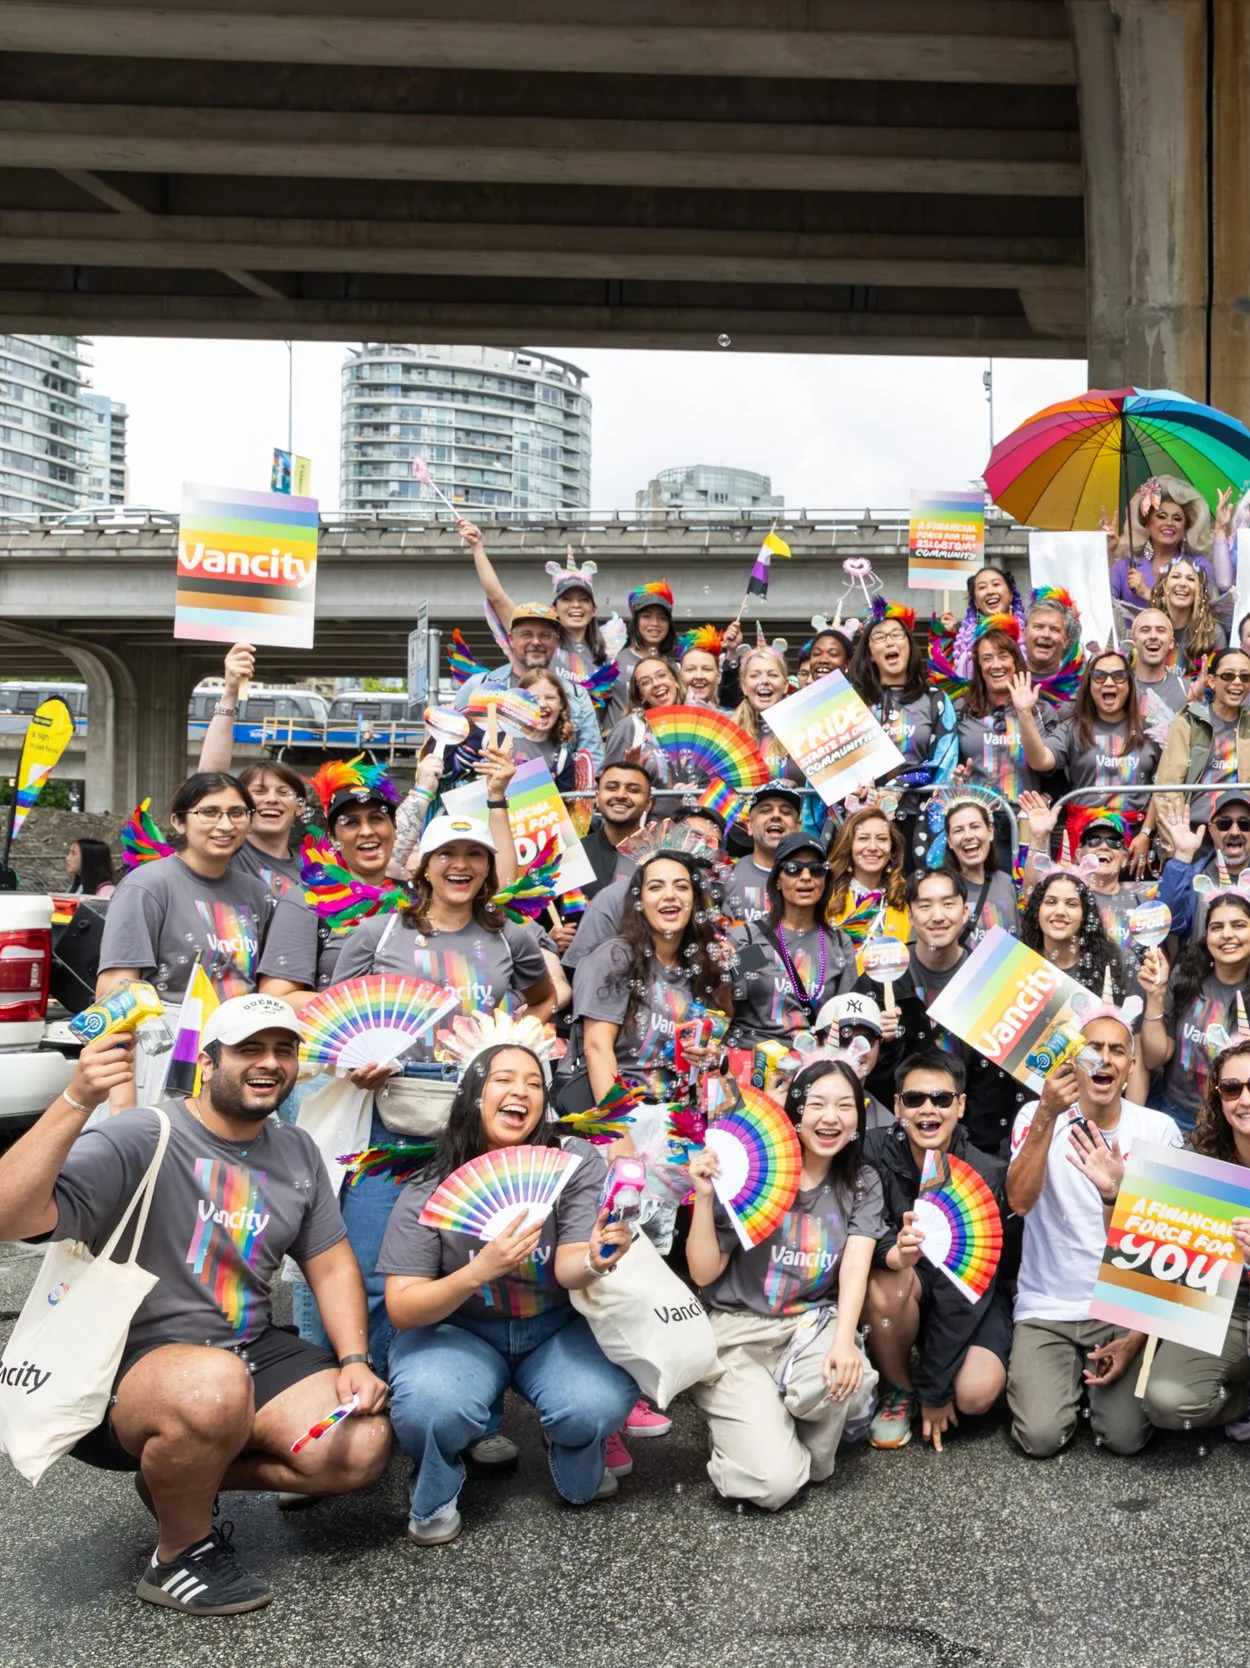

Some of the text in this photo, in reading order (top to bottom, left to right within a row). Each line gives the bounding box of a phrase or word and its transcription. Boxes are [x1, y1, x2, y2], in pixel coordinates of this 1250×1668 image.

[178, 541, 316, 589] Vancity
[915, 548, 977, 560] COMMUNITY
[791, 701, 870, 758] PRIDE
[983, 732, 1023, 747] Vancit
[799, 740, 839, 768] STARTS
[839, 734, 851, 746] IN
[1096, 755, 1140, 770] Vancity
[976, 967, 1063, 1057] Vancity
[1132, 1197, 1147, 1215] A
[1123, 1214, 1236, 1260] FORCE FOR
[771, 1245, 839, 1273] Vancity
